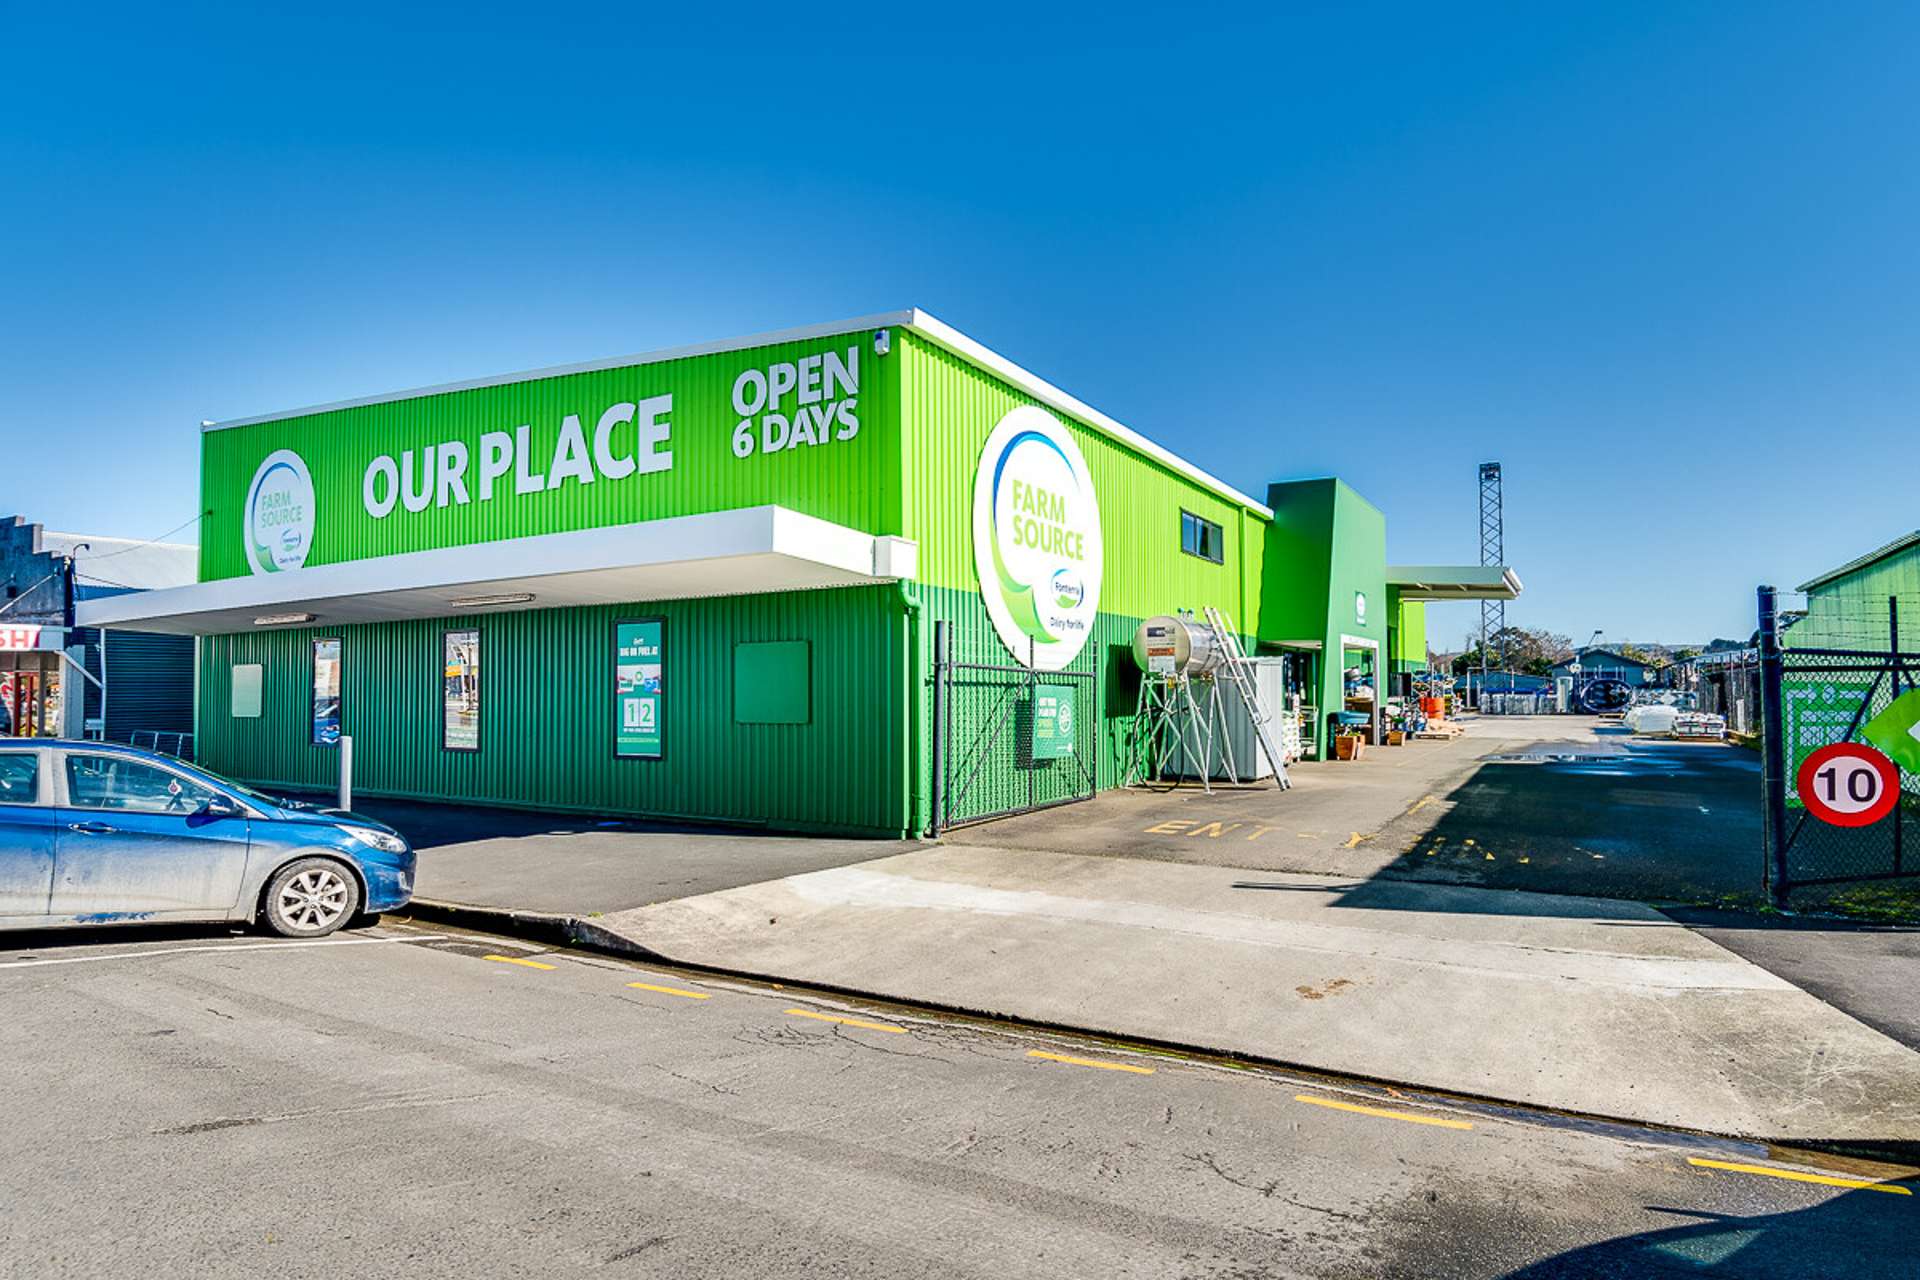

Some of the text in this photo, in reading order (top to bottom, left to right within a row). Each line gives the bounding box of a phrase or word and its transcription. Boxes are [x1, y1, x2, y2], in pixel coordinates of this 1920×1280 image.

[731, 345, 860, 417] OPEN
[731, 398, 860, 459] 6 DAYS
[363, 393, 674, 519] OUR PLACE
[261, 489, 291, 511] FARM
[261, 505, 303, 529] SOURCE
[1012, 479, 1066, 524] FARM
[1013, 514, 1084, 561] SOURCE
[1817, 767, 1877, 802] 10
